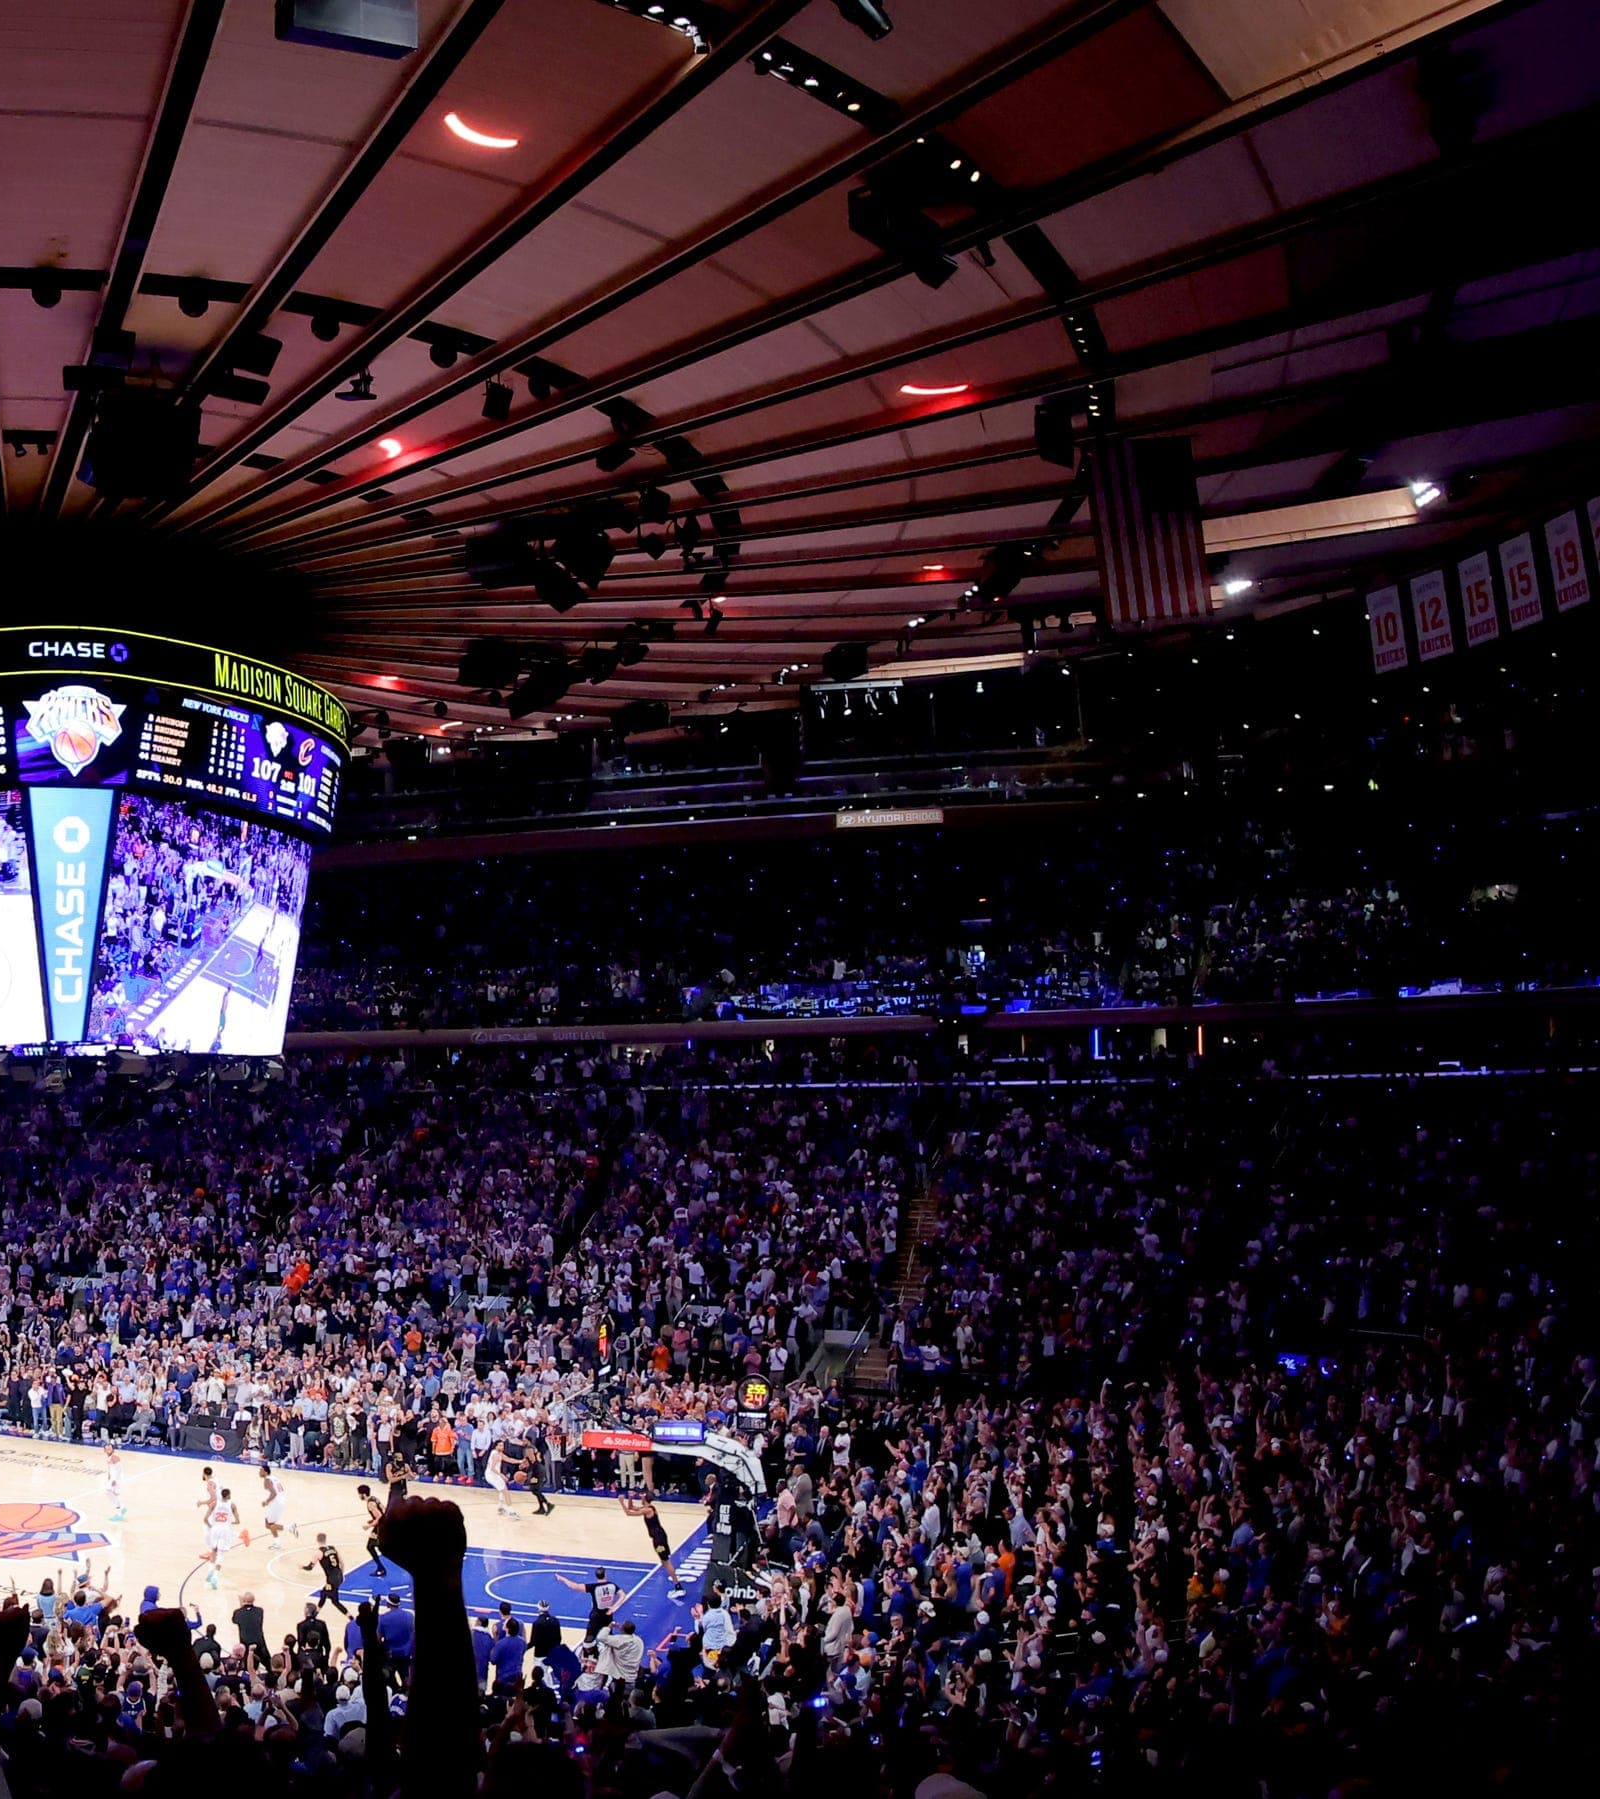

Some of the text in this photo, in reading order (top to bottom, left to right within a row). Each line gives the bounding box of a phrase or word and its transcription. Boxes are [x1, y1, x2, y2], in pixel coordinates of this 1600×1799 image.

[1555, 540, 1578, 581] 19
[1508, 561, 1530, 600] 15
[1558, 579, 1587, 605] KNICKS
[1466, 580, 1488, 617] 15
[1419, 597, 1444, 632] 12
[1510, 600, 1540, 623] KNICKS
[1375, 612, 1397, 646] 10
[1468, 617, 1496, 640] KNICKS
[28, 641, 105, 658] CHASE
[1420, 633, 1451, 656] KNICKS
[1376, 647, 1407, 667] KNICKS
[215, 653, 281, 704] MADISON
[285, 674, 323, 721] SQUARE
[163, 774, 182, 785] 30.0
[251, 757, 281, 783] 107
[298, 773, 316, 797] 101
[857, 813, 904, 824] HYUNDAI
[54, 860, 87, 1004] CHASE
[745, 1394, 762, 1406] 24
[215, 1512, 229, 1522] 25
[329, 1554, 337, 1567] 5
[725, 1585, 757, 1599] oinb
